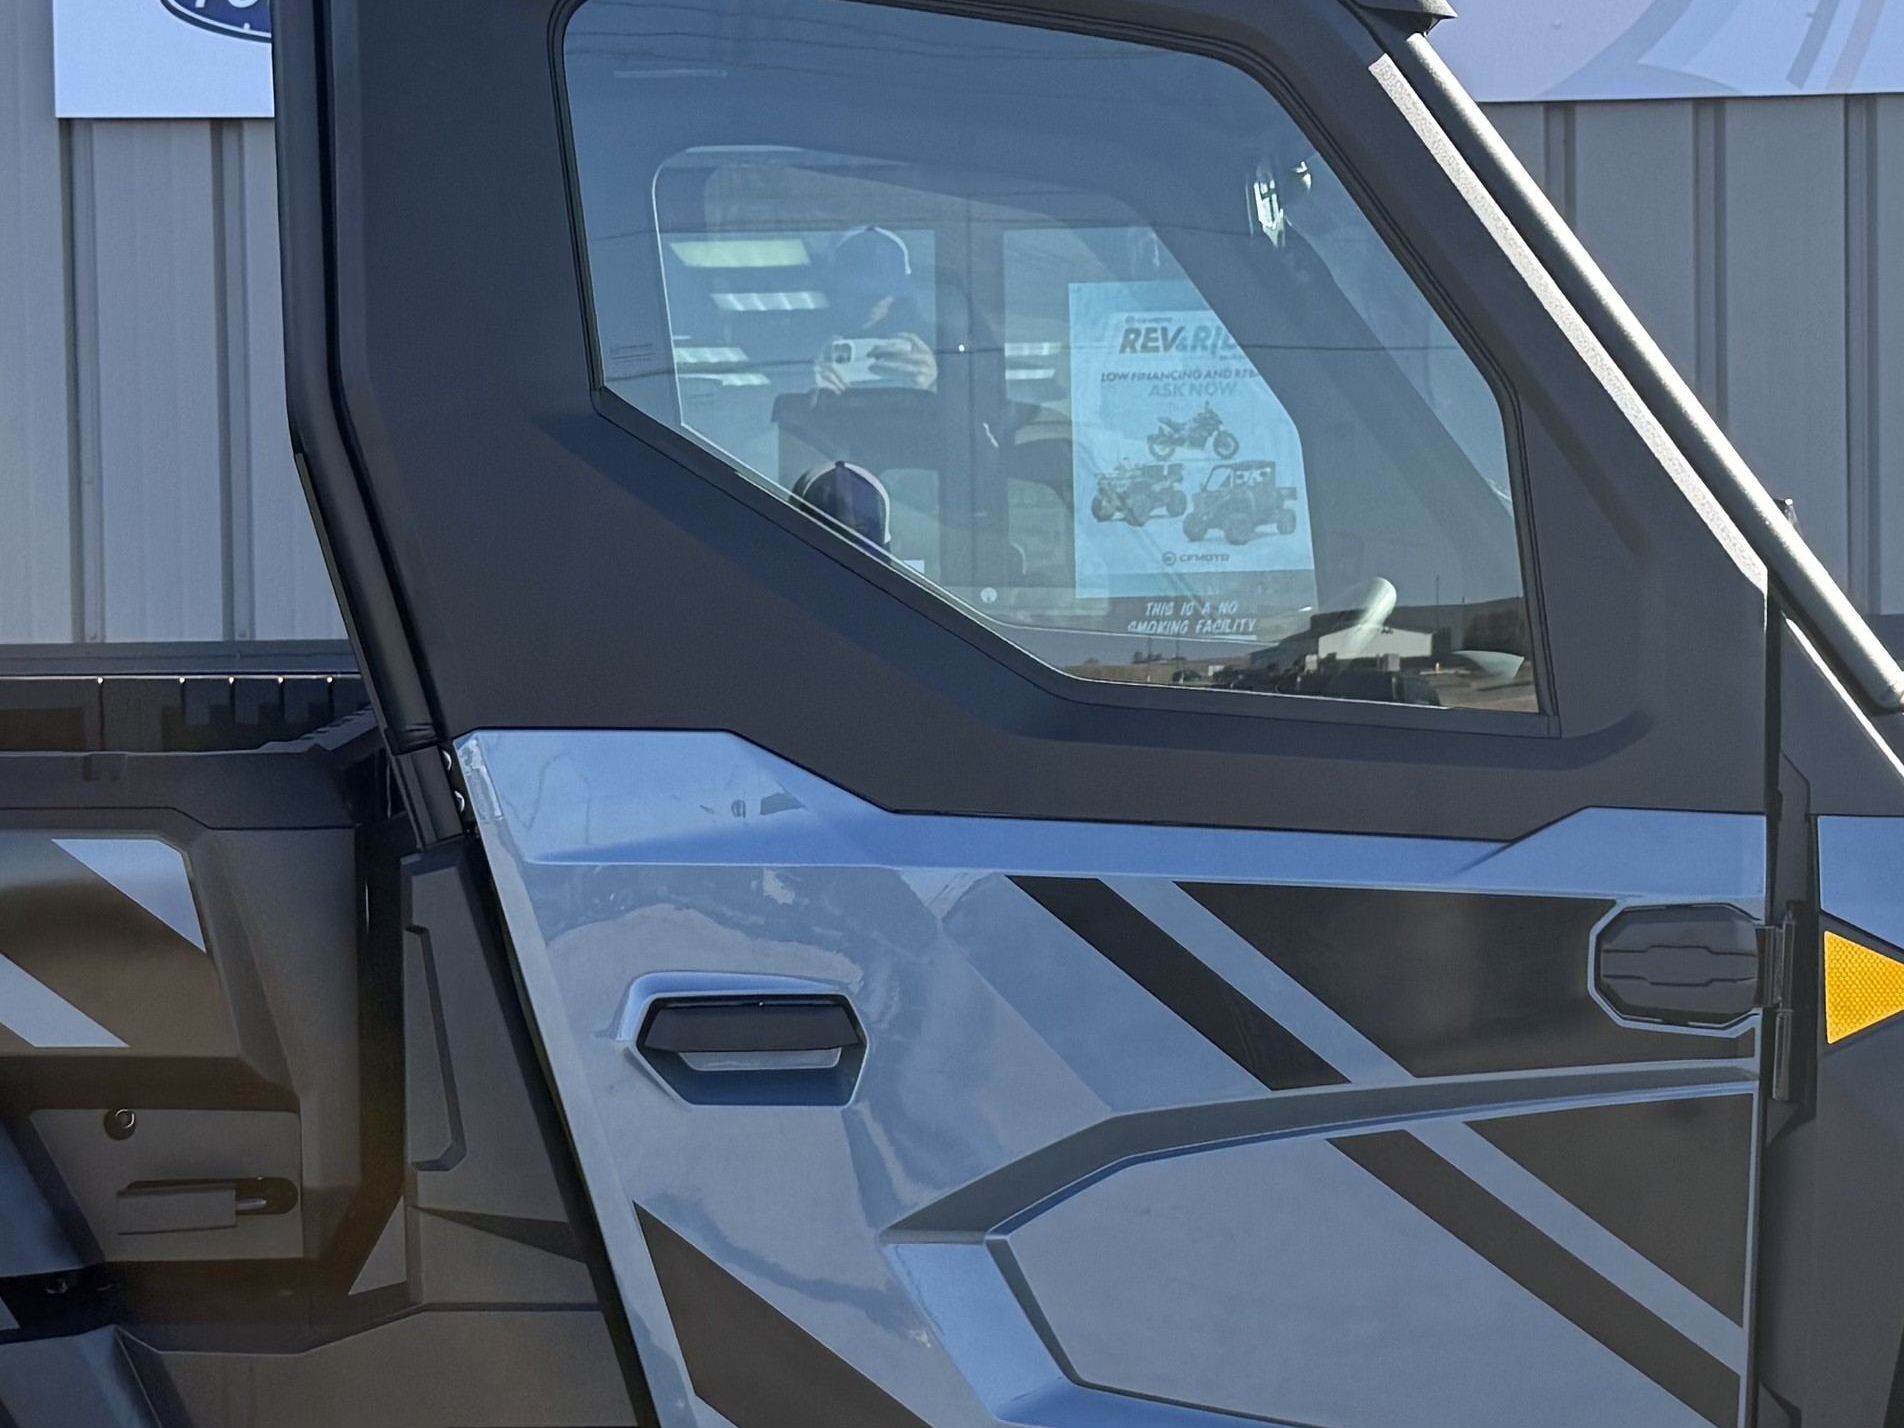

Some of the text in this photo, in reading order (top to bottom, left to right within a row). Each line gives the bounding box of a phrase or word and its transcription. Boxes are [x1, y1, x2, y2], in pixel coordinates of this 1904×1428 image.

[1100, 371, 1129, 383] LOW
[1130, 369, 1202, 382] FINANCING
[1204, 368, 1234, 380] AND
[1148, 381, 1238, 398] ASK NOW
[1145, 600, 1238, 616] THIS IS A NO
[1127, 618, 1257, 634] SMOKING FACILITY
